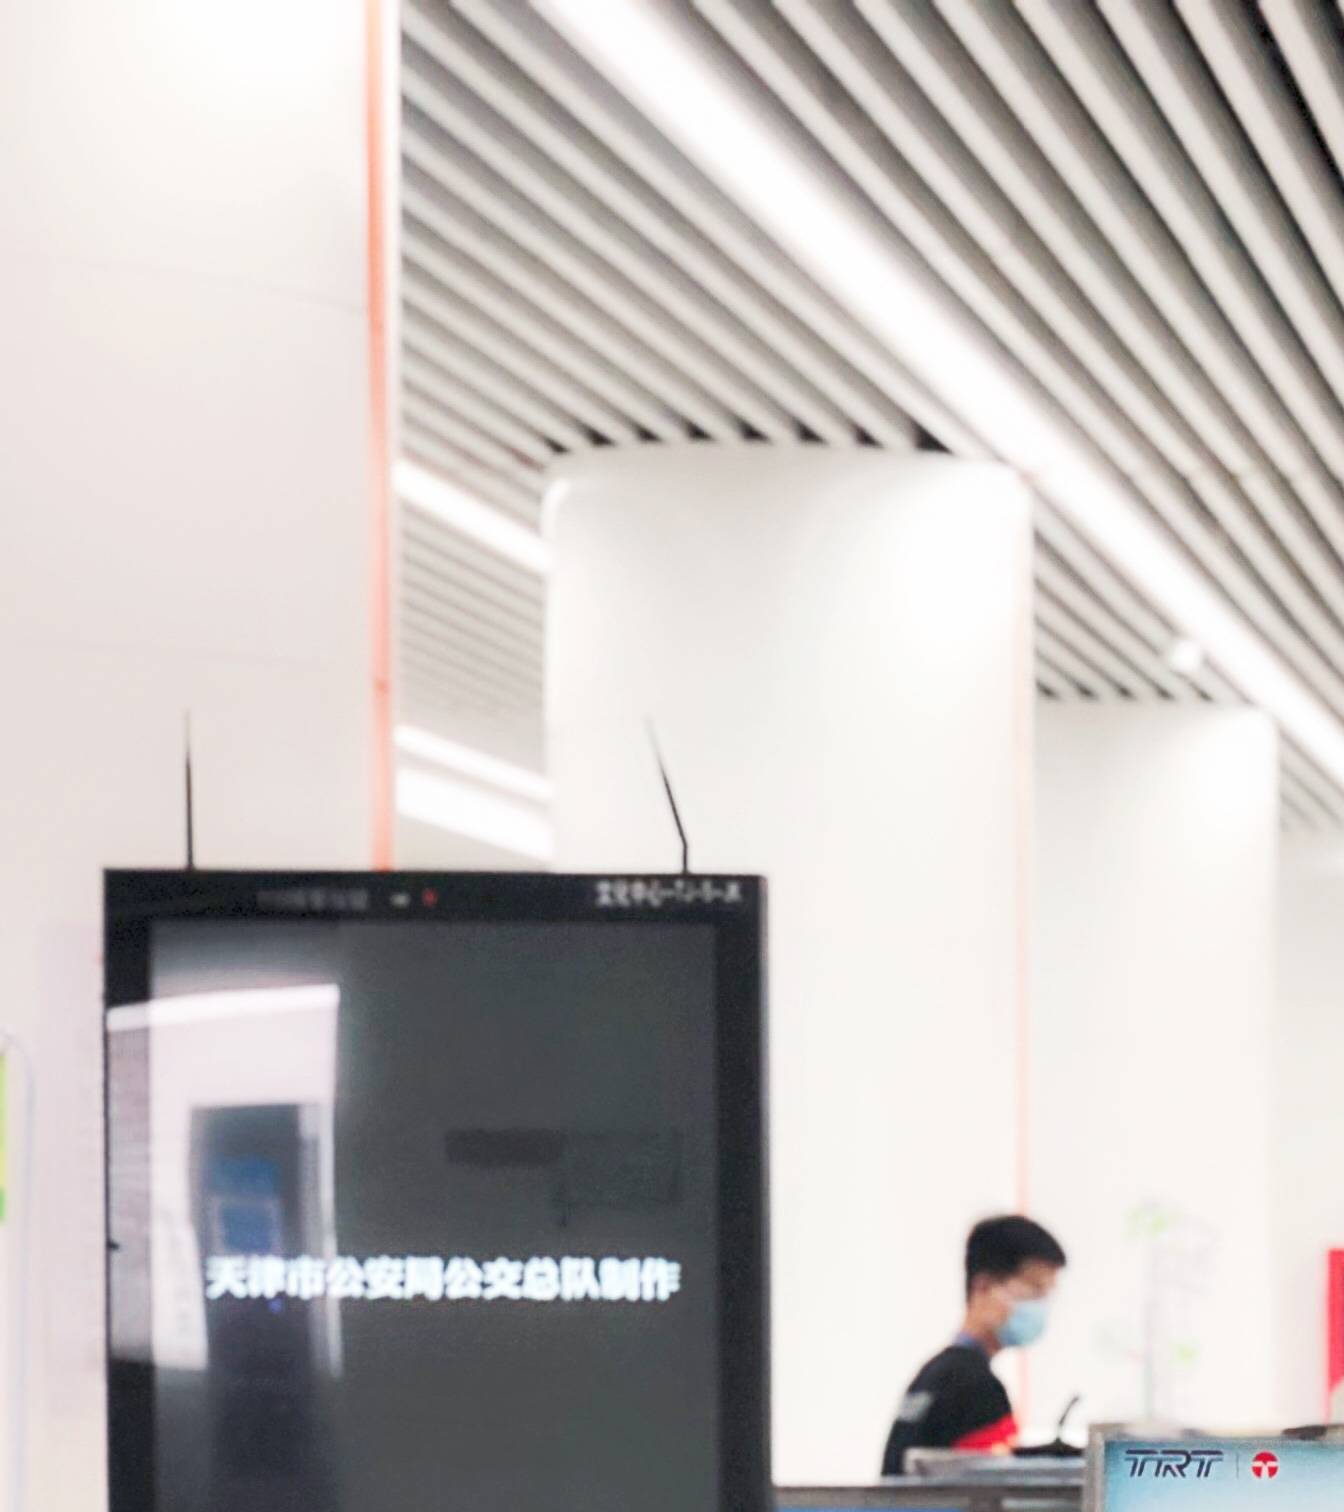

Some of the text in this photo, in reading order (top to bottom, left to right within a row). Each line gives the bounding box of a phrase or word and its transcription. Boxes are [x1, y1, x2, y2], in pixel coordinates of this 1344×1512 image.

[205, 1254, 681, 1301] 天津市公安局公交总队制作
[1125, 1449, 1224, 1478] TRT
